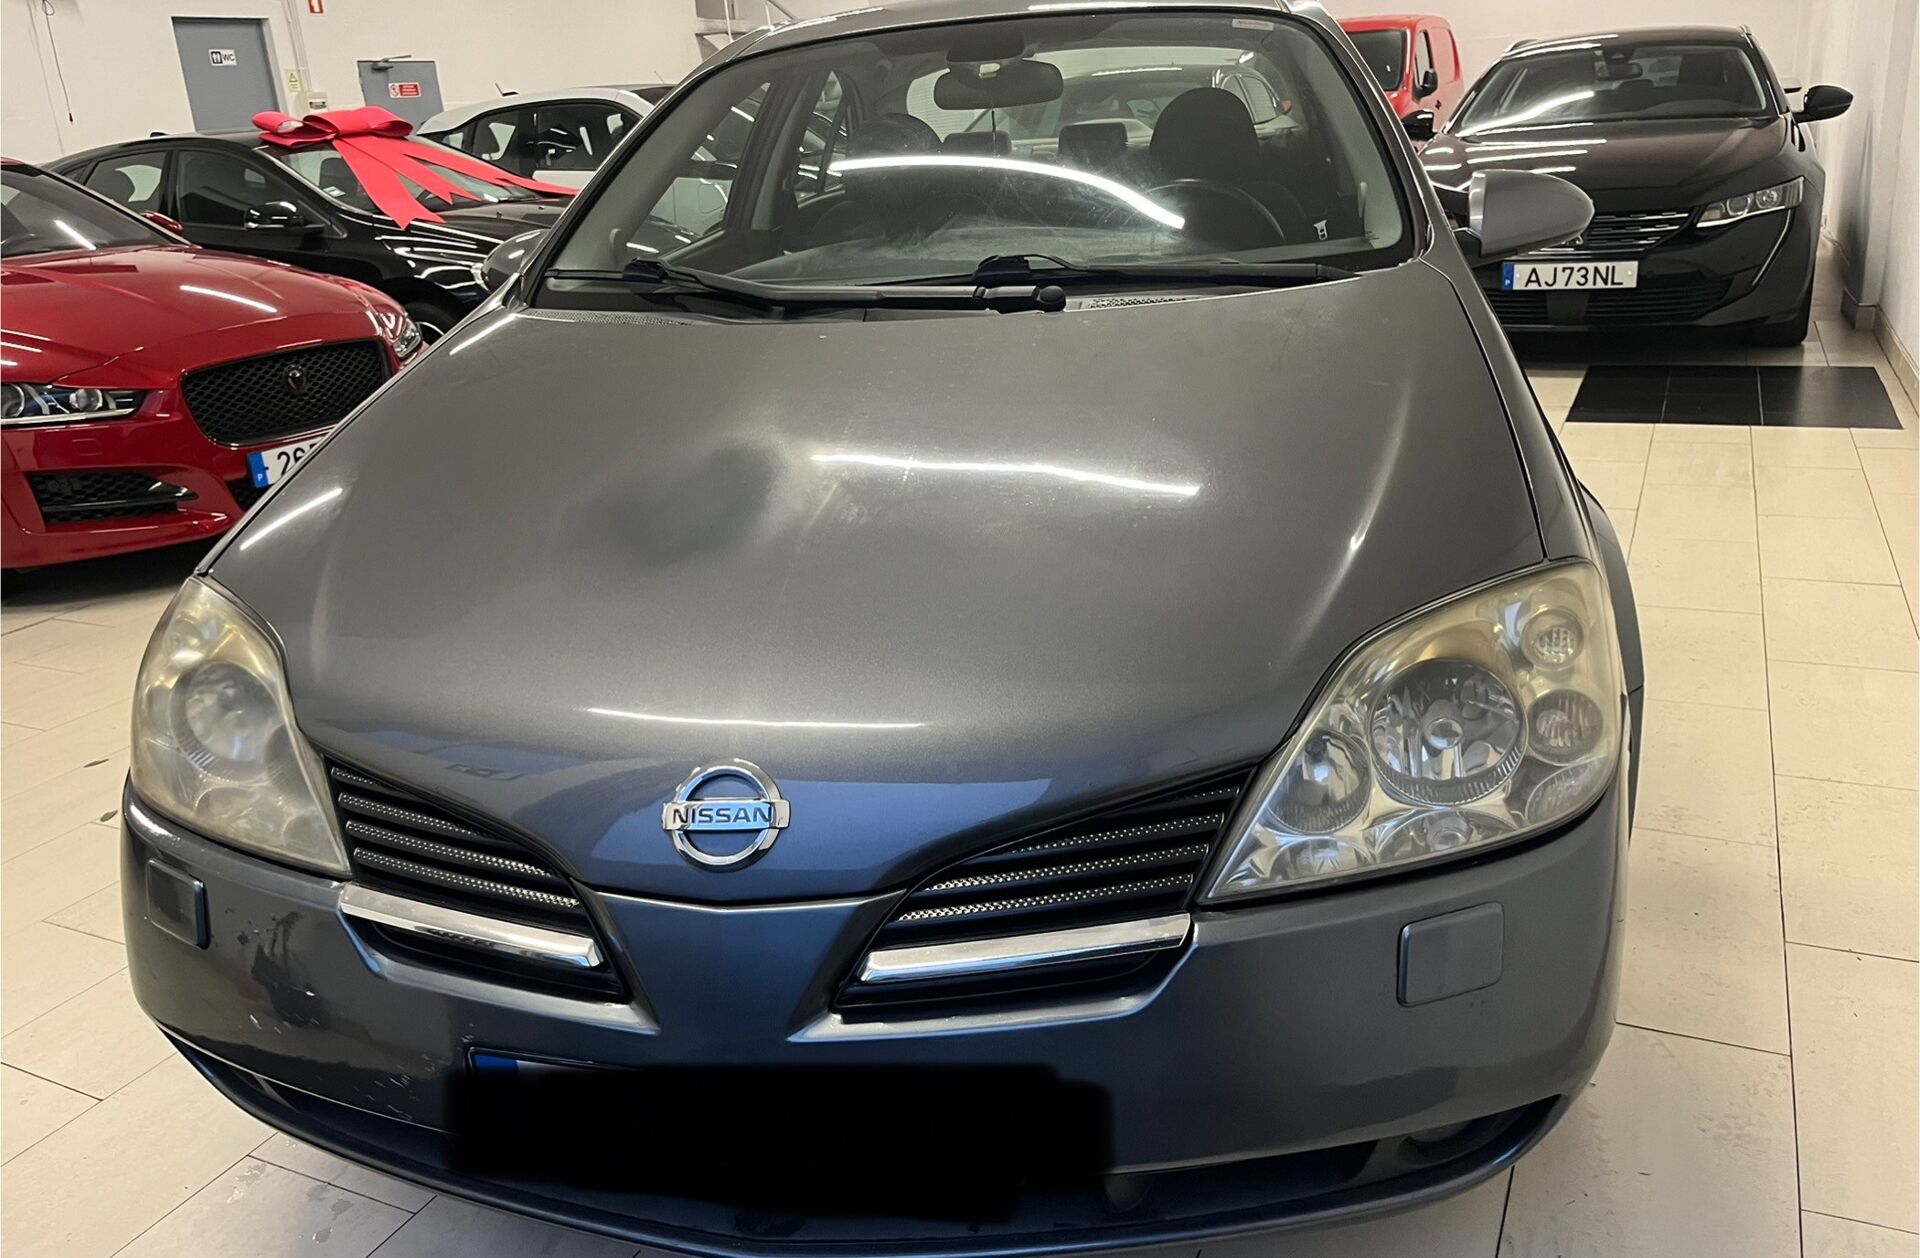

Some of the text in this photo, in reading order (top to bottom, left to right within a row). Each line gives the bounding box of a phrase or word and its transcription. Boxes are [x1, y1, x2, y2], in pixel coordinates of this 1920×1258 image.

[222, 52, 236, 63] WC
[1525, 265, 1624, 287] AJ73NL
[257, 473, 263, 481] P
[673, 806, 772, 825] NISSAN
